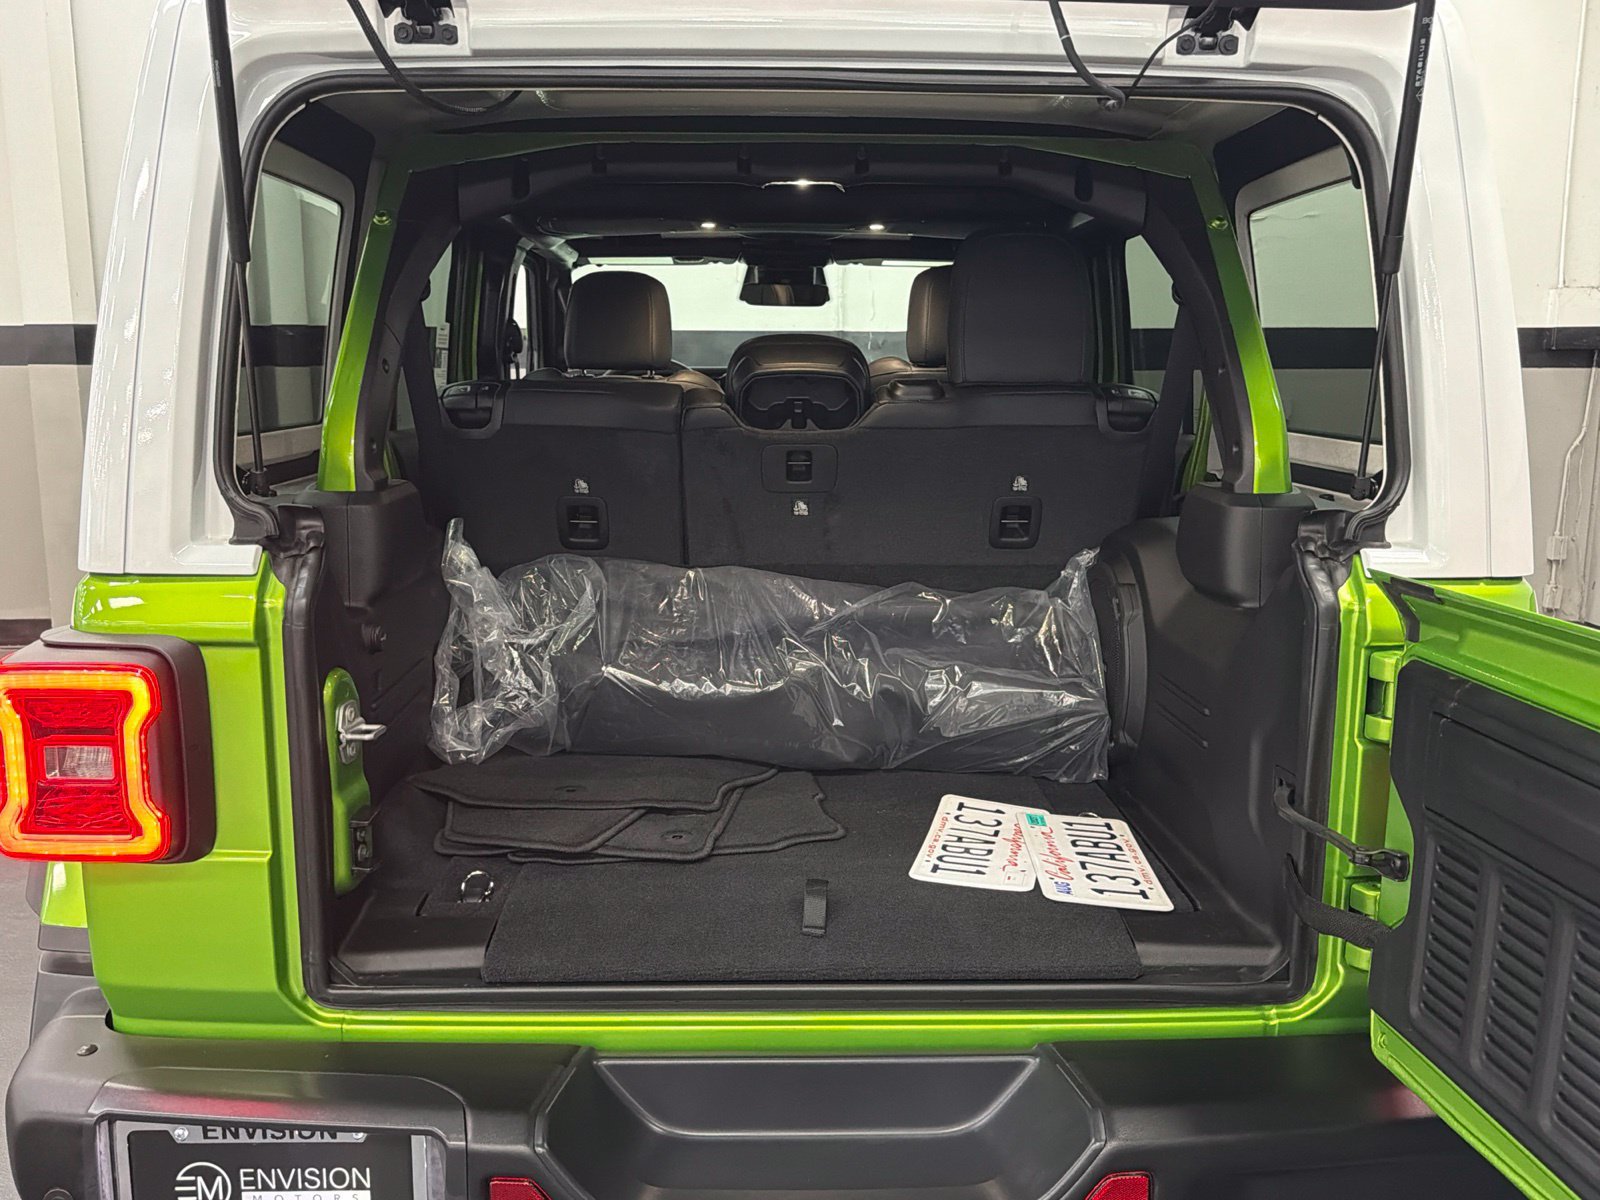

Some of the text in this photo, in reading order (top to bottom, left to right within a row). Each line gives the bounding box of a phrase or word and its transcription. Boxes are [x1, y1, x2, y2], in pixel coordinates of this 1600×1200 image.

[1415, 38, 1426, 87] STABILUS
[927, 816, 949, 858] dmv.ca.gov
[930, 802, 1006, 875] 137ABU1
[1039, 826, 1074, 881] California
[1062, 821, 1150, 900] 137ABU1
[1123, 836, 1154, 886] dmv.ca.gov
[1054, 881, 1073, 896] AUG
[202, 1125, 338, 1140] ENVISION
[240, 1167, 371, 1190] ENVISION
